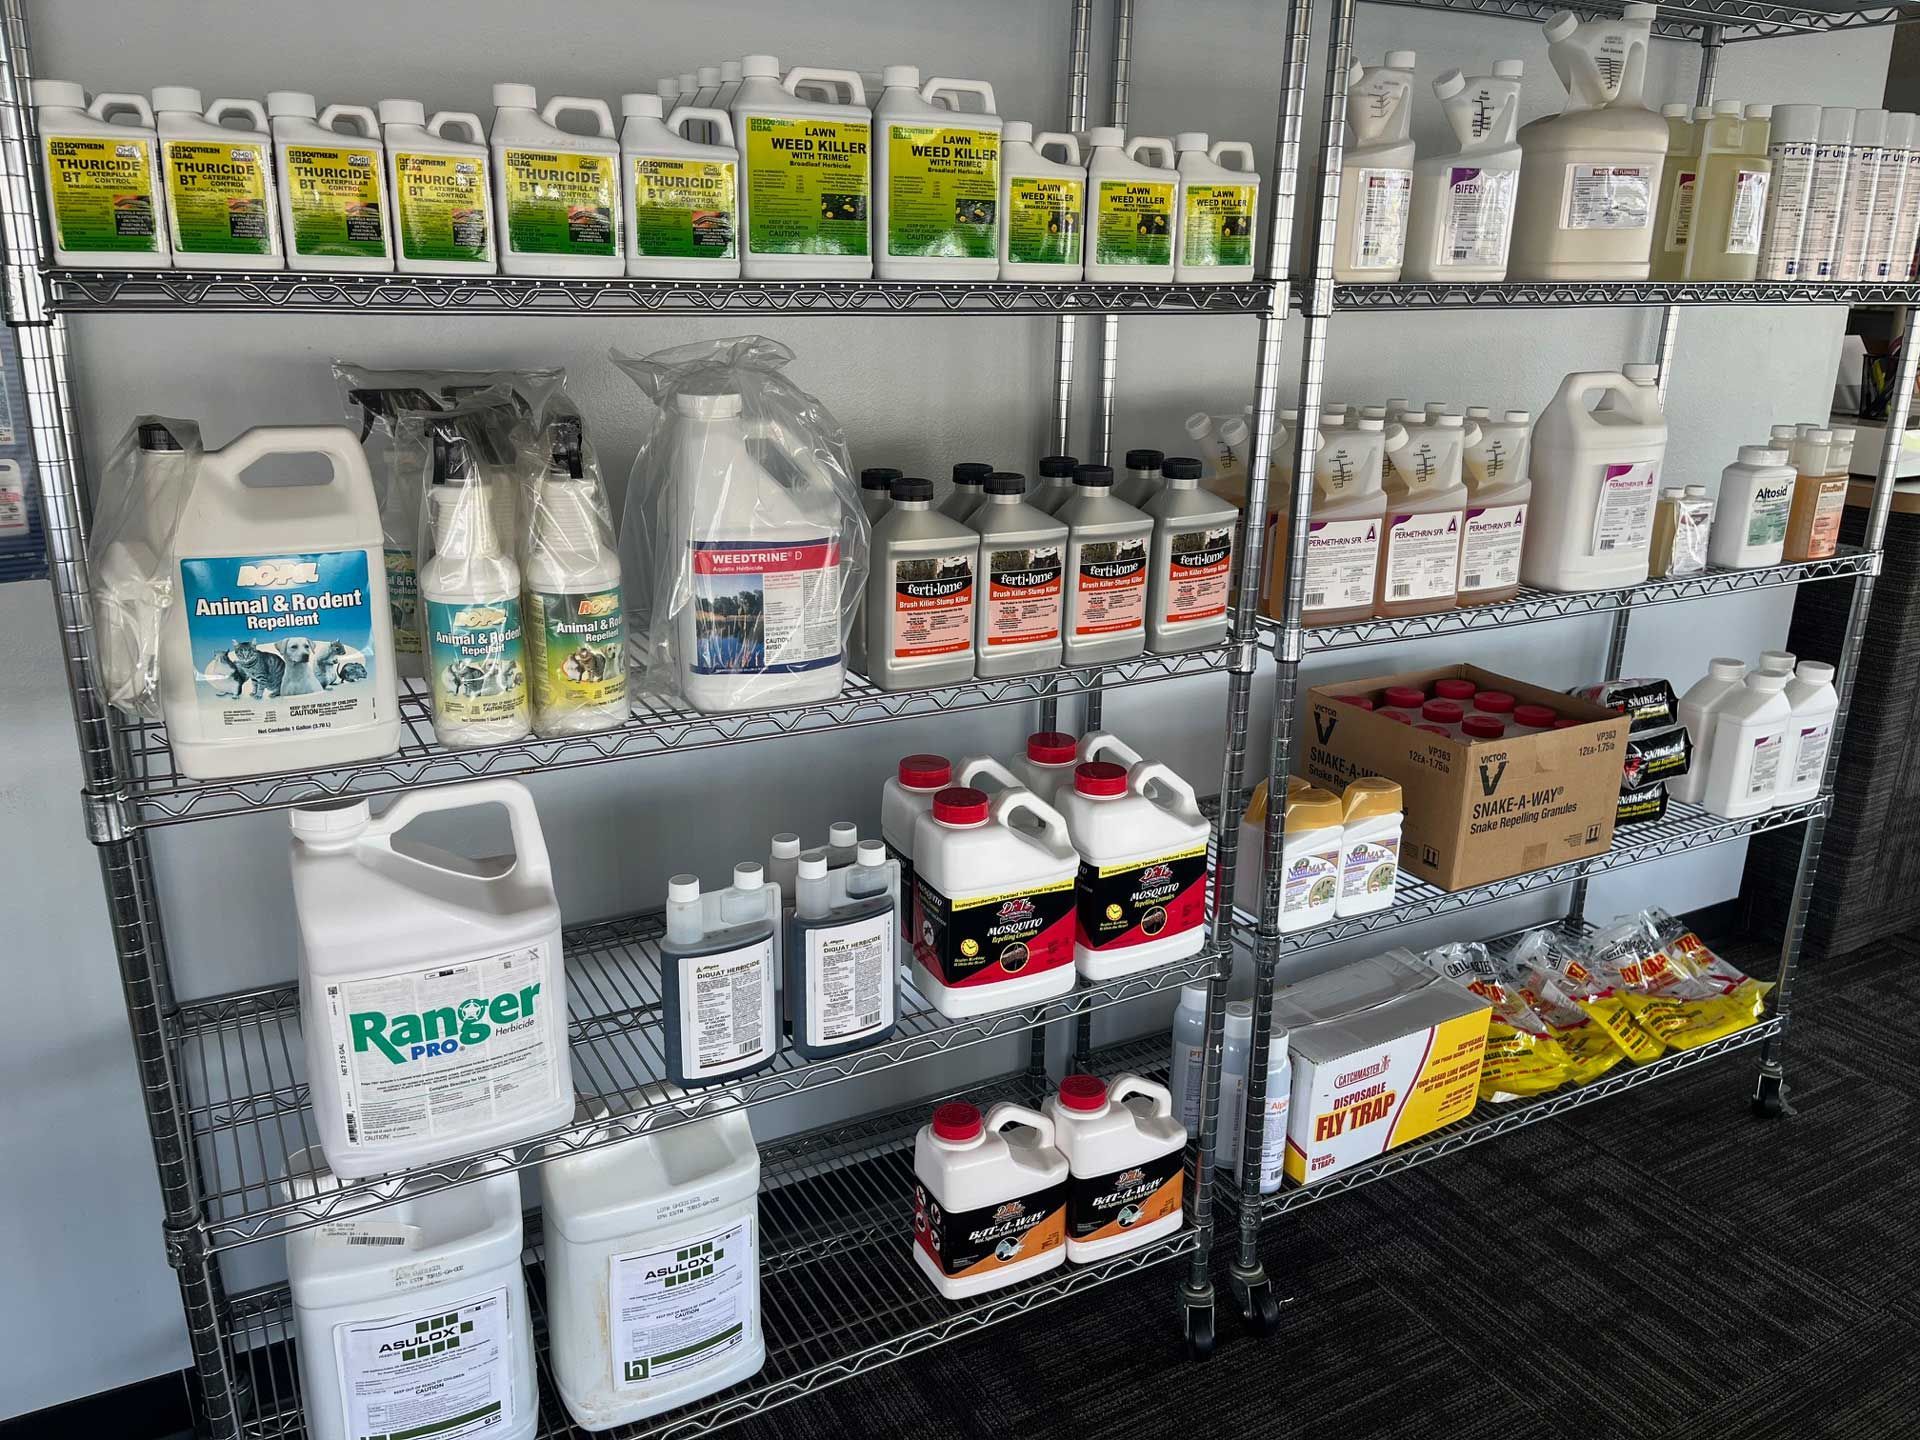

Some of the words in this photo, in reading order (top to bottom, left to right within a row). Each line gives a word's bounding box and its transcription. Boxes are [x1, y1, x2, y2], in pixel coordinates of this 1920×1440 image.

[805, 128, 835, 137] LAWN
[772, 138, 813, 150] WEED
[818, 140, 866, 154] KILLER
[943, 136, 971, 145] LAWN
[520, 153, 557, 162] SOUTHERN
[912, 146, 950, 157] WEED
[955, 148, 997, 160] KILLER
[57, 159, 140, 171] THURICIDE
[175, 162, 254, 174] THURICIDE
[649, 161, 683, 169] SOUTHERN
[63, 172, 81, 182] BT
[295, 167, 371, 179] THURICIDE
[515, 168, 600, 183] THURICIDE
[180, 175, 197, 185] BT
[300, 179, 316, 189] BT
[645, 176, 722, 189] THURICIDE
[409, 186, 424, 196] BT
[520, 182, 538, 192] BT
[547, 184, 599, 192] CATERPILLAR
[1038, 184, 1060, 192] LAWN
[1455, 184, 1479, 193] BIFEN
[648, 189, 665, 198] BT
[1021, 192, 1044, 200] WEED
[1136, 196, 1164, 204] KILLER
[769, 230, 799, 238] CAUTION
[1756, 485, 1787, 500] Altosid
[1469, 523, 1503, 531] PERMETHRIN
[1395, 530, 1432, 538] PERMETHRIN
[795, 551, 802, 560] D
[195, 595, 268, 616] Animal
[273, 595, 289, 612] &
[291, 589, 361, 611] Rodent
[247, 613, 319, 631] Repellent
[557, 621, 597, 632] Animal
[601, 620, 608, 629] &
[436, 632, 474, 644] Animal
[478, 634, 487, 644] &
[490, 626, 521, 642] Rodent
[586, 629, 618, 641] Repellent
[462, 644, 504, 656] Repellent
[290, 709, 318, 717] CAUTION
[1315, 704, 1336, 717] VICTOR
[1429, 746, 1450, 761] VP363
[1481, 753, 1507, 763] VICTOR
[1308, 764, 1332, 778] Snake
[1471, 821, 1497, 834] Snake
[1500, 811, 1539, 828] Repelling
[1541, 803, 1577, 819] Granules
[1102, 864, 1140, 875] Independently
[1131, 883, 1179, 901] MOSQUITO
[955, 898, 998, 908] Independently
[1000, 892, 1018, 900] Tested
[1135, 900, 1155, 908] Repelling
[1156, 894, 1174, 902] Granules
[987, 918, 1042, 936] MOSQUITO
[992, 933, 1015, 943] Repelling
[1016, 930, 1037, 938] Granules
[824, 945, 849, 953] DIQUAT
[851, 936, 880, 947] HERBICIDE
[698, 970, 724, 979] DIQUAT
[727, 960, 759, 973] HERBICIDE
[349, 982, 541, 1064] Ranger
[496, 1019, 534, 1036] Herbicide
[1458, 1035, 1485, 1050] DISPOSABLE
[411, 1039, 458, 1060] PRO
[1339, 1064, 1380, 1086] CATCHMASTER
[1417, 1072, 1446, 1088] FOOD-BASED
[1447, 1067, 1458, 1076] LURE
[1460, 1058, 1480, 1071] INCLUDED
[450, 1080, 469, 1088] Directions
[1435, 1080, 1443, 1088] ADD
[1445, 1076, 1458, 1084] WATER
[1334, 1082, 1386, 1110] DISPOSABLE
[1316, 1111, 1347, 1142] FLY
[1350, 1093, 1395, 1130] TRAP
[1318, 1157, 1335, 1169] TRAPS
[1092, 1177, 1163, 1206] BAT-A-WAY
[969, 1211, 1045, 1240] BAT-A-WAY
[645, 1256, 709, 1280] ASULOX
[675, 1308, 699, 1319] CAUTION
[379, 1327, 455, 1353] ASULOX
[630, 1361, 643, 1376] h
[416, 1383, 444, 1394] CAUTION
